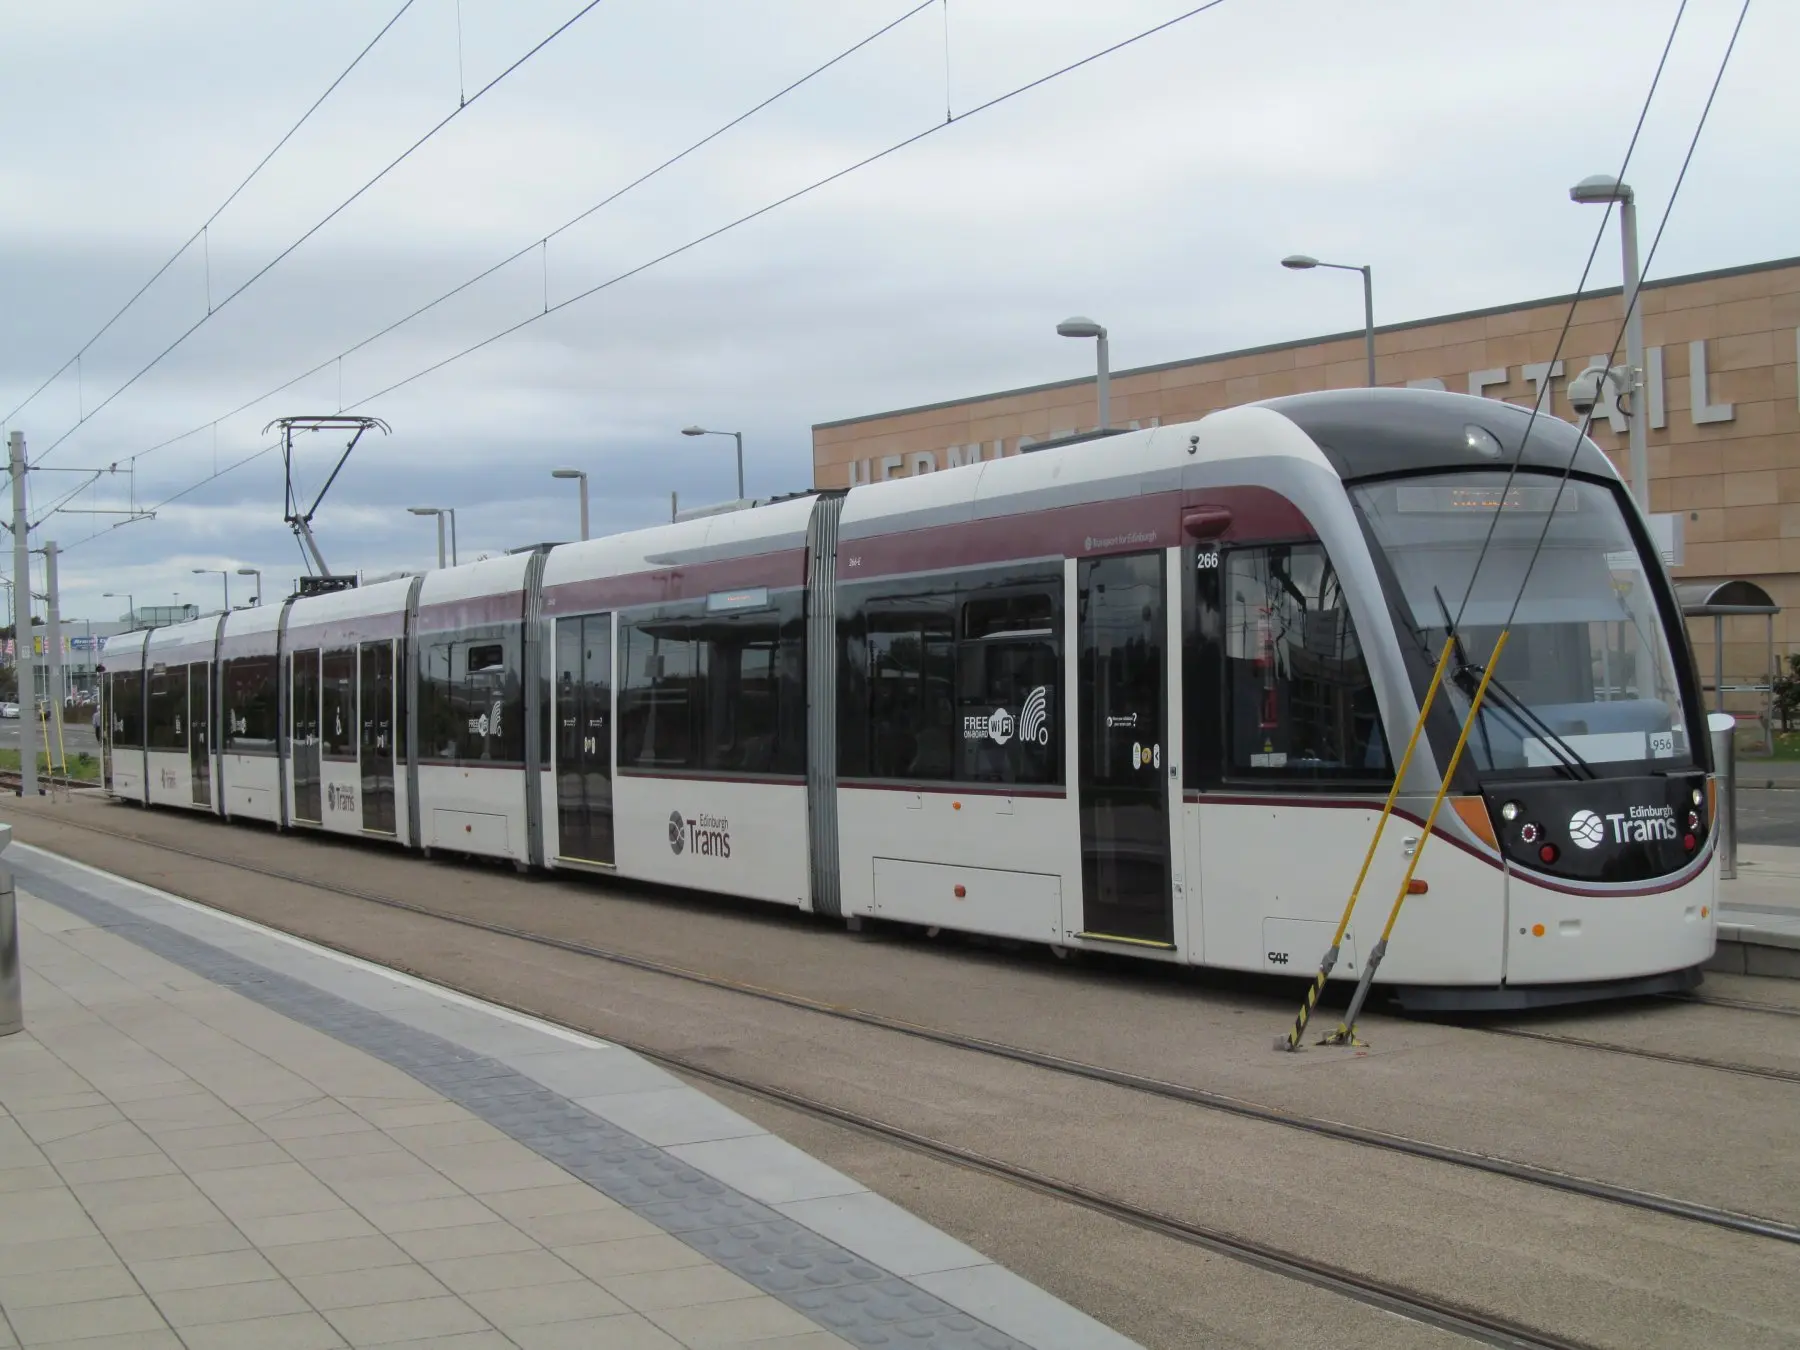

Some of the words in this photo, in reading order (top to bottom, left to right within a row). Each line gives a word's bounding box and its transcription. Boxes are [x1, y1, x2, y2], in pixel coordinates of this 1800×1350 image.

[1406, 340, 1736, 433] TAIL
[1197, 552, 1218, 568] 266
[964, 716, 988, 729] FREE
[1653, 739, 1672, 750] 956
[1629, 804, 1673, 818] Edinburgh
[700, 813, 729, 831] Edinburgh
[1605, 813, 1677, 844] Trams
[686, 819, 731, 858] Trams
